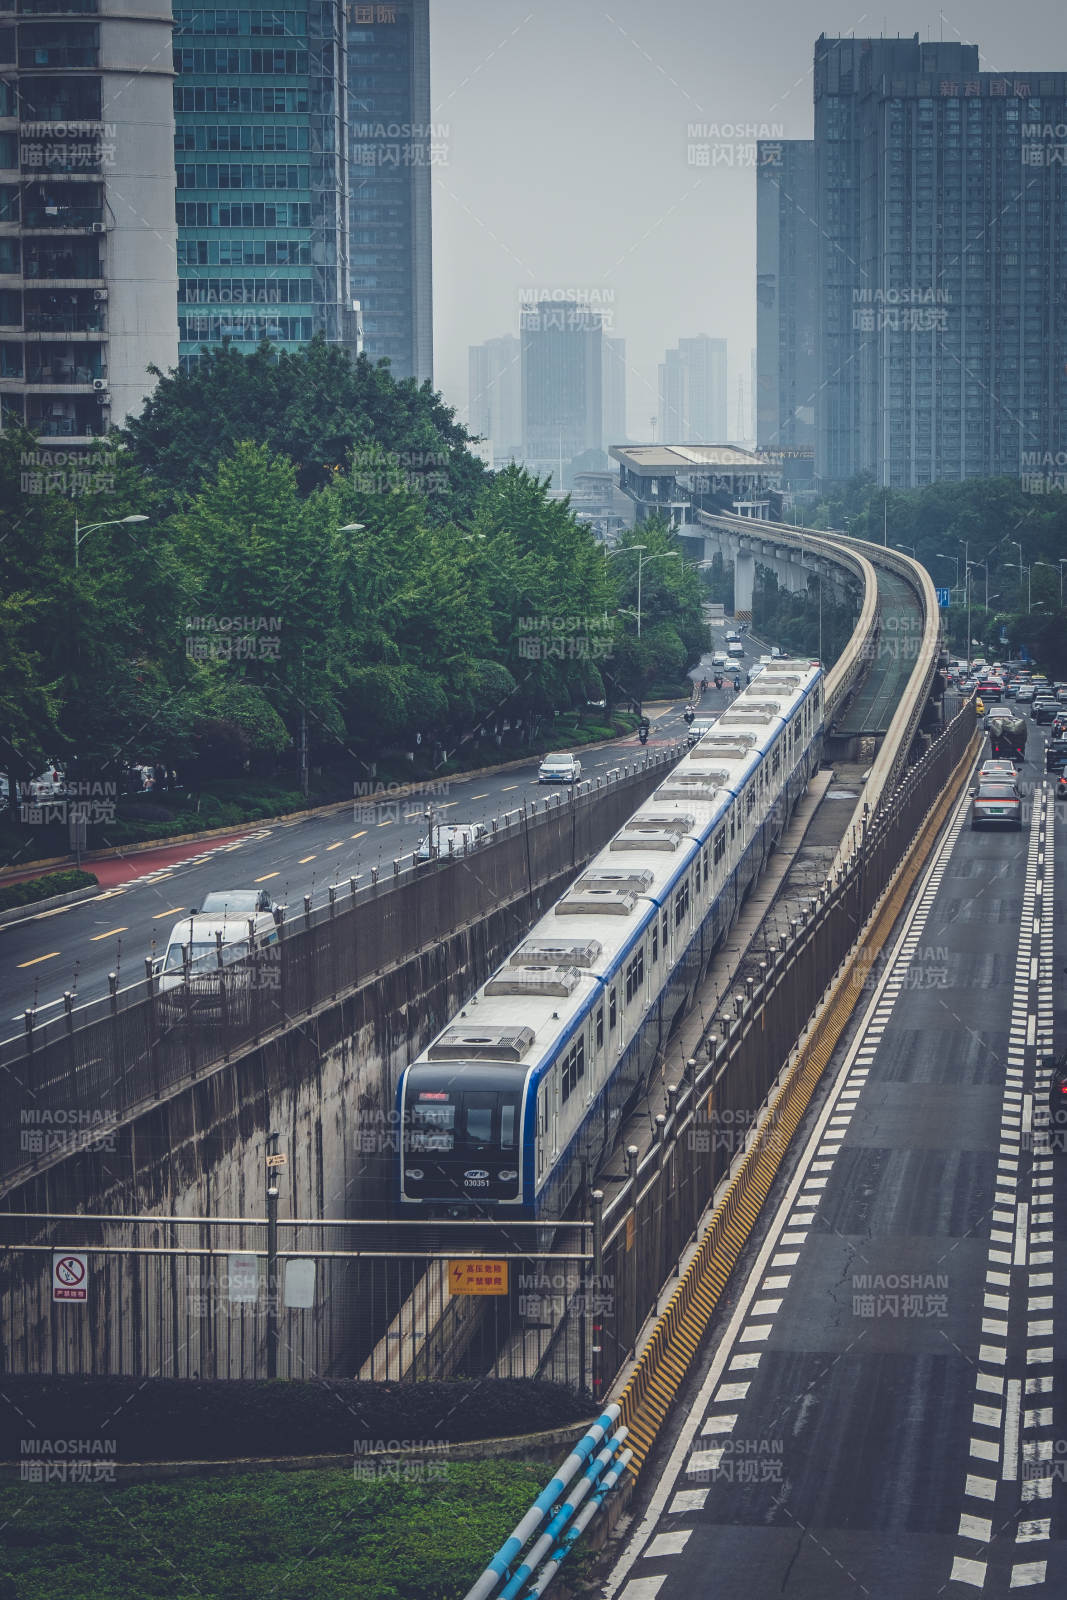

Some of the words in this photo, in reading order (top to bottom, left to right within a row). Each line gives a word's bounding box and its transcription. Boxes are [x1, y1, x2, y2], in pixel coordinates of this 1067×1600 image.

[346, 5, 396, 24] 国际
[940, 80, 1032, 97] 新科国际
